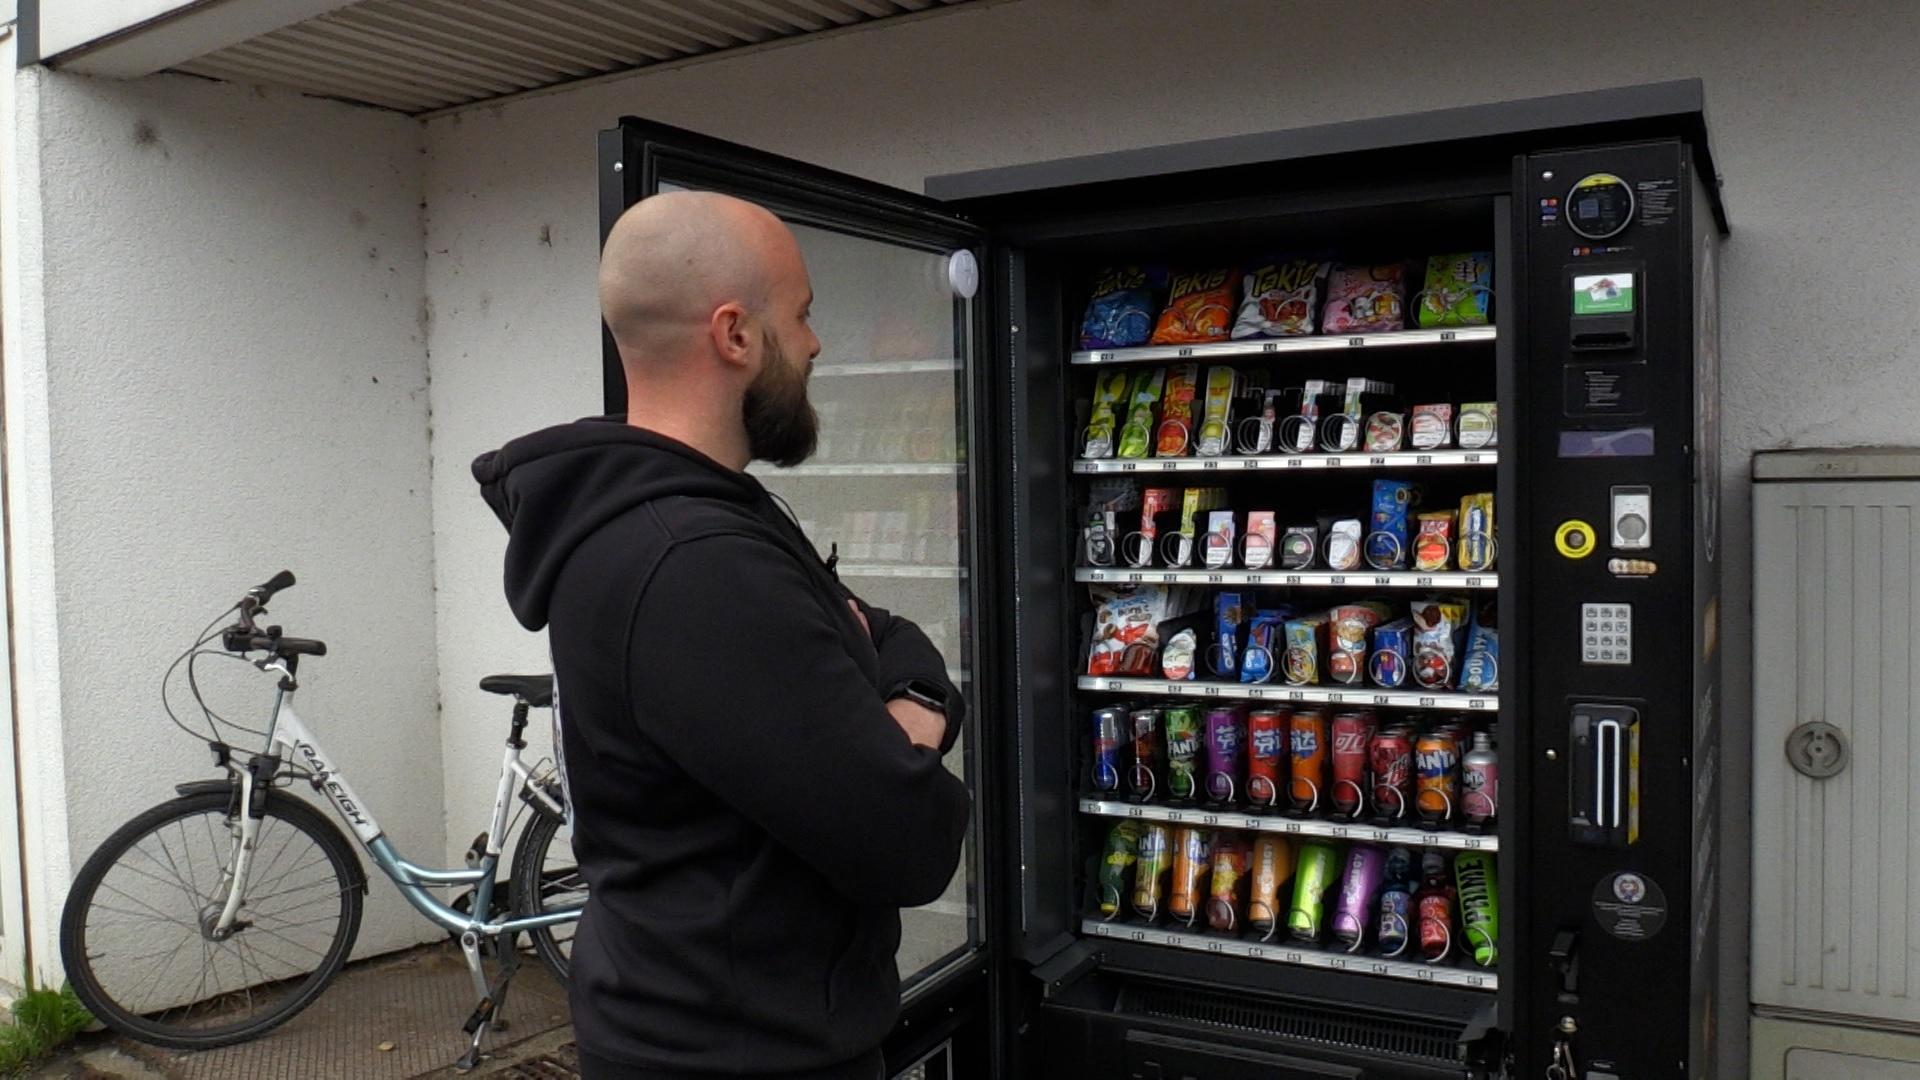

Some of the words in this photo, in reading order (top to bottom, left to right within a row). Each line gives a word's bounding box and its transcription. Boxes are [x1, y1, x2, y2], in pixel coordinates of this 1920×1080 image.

[1168, 269, 1227, 305] Takis
[1252, 262, 1319, 298] Takis
[1167, 739, 1200, 757] FANT
[1415, 749, 1456, 770] ANTA
[298, 743, 369, 826] RAEIGH
[1458, 859, 1491, 927] PRIME
